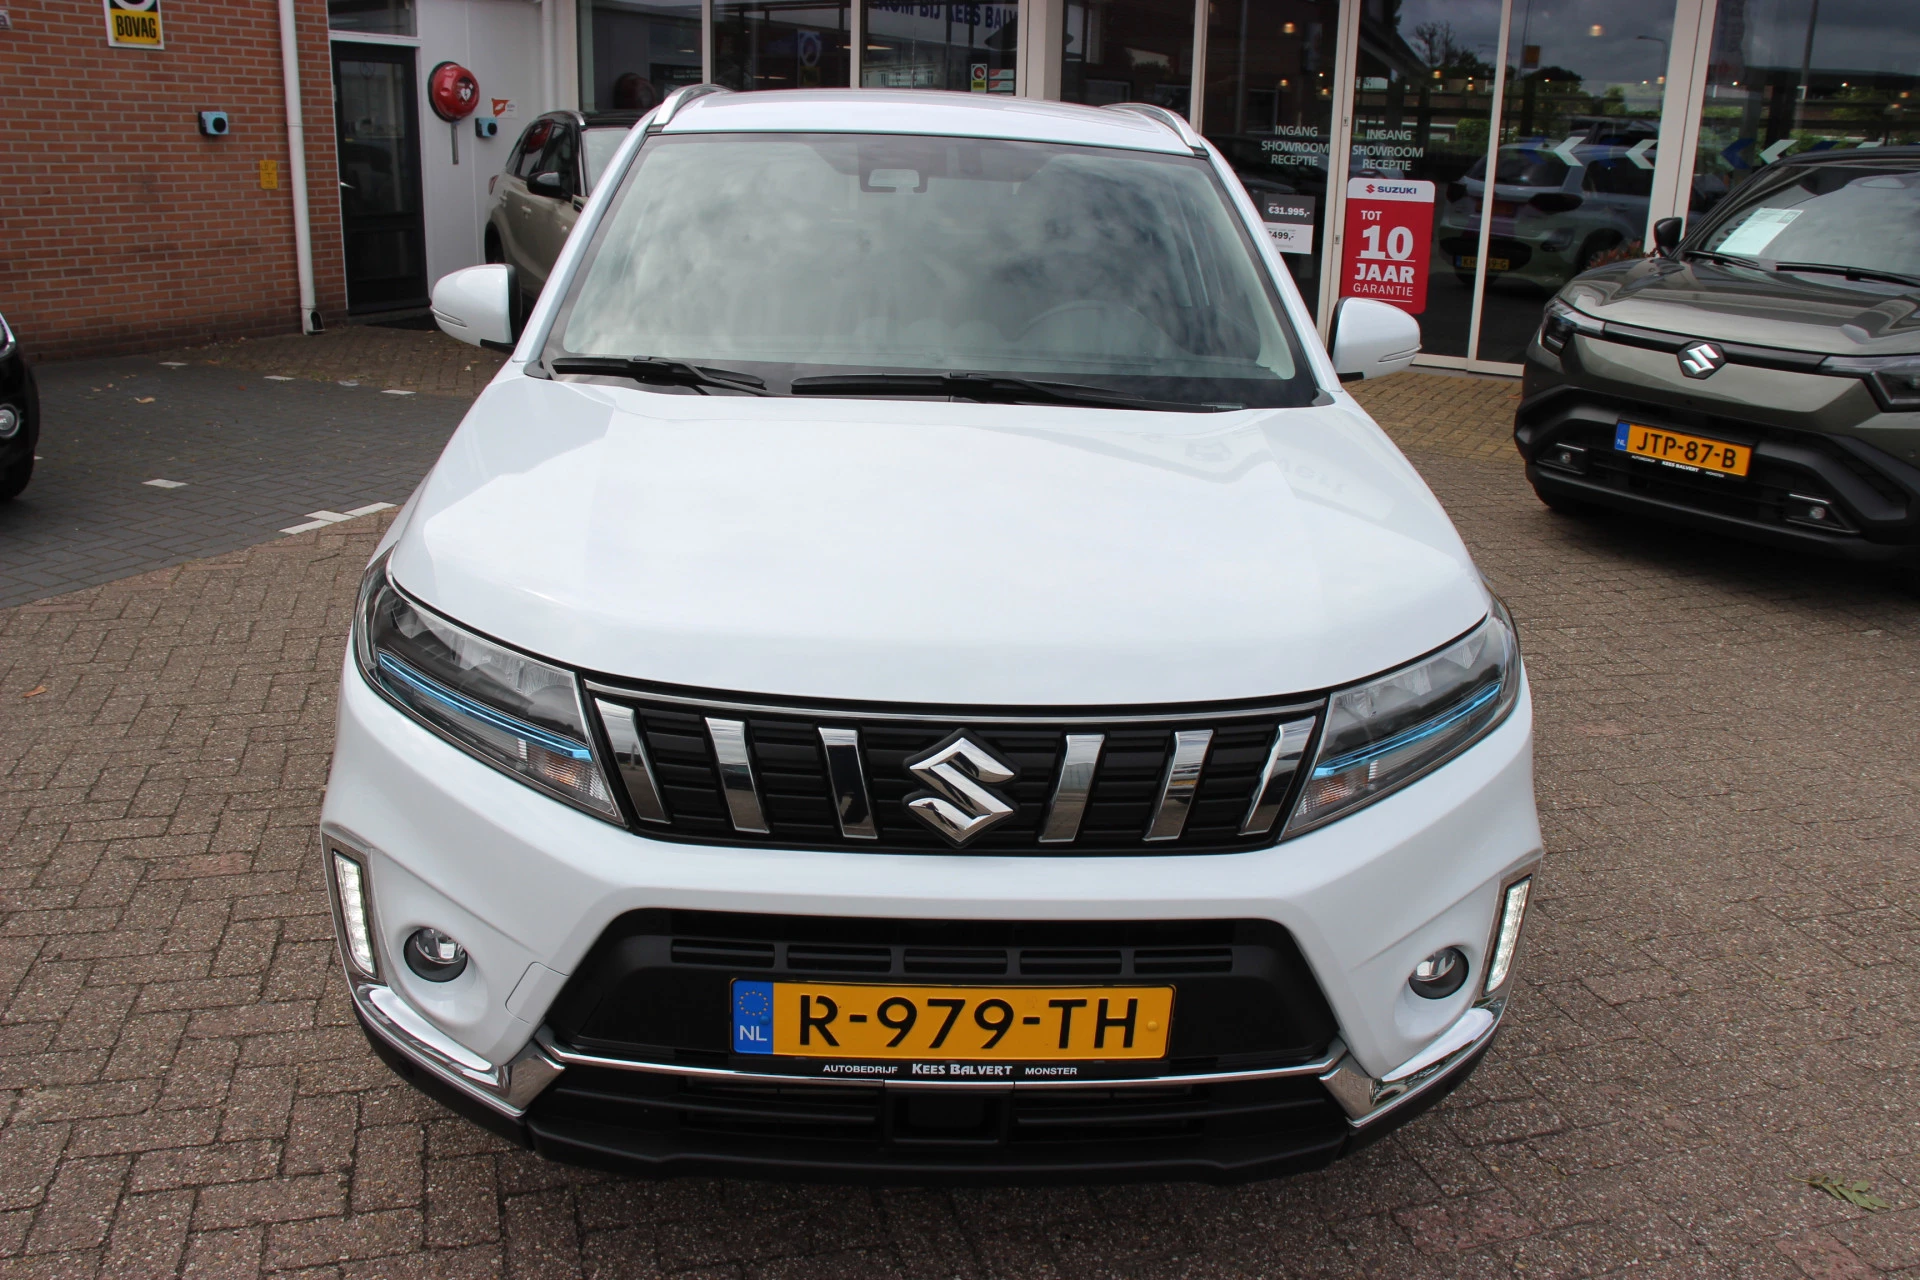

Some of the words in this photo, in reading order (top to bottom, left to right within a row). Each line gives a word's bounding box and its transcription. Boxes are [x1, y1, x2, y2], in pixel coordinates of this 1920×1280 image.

[115, 14, 157, 39] BOVAG
[1274, 125, 1318, 137] INGANG
[1366, 129, 1412, 141] INGANG
[1261, 140, 1330, 153] SHOWROOM
[1352, 145, 1424, 158] SHOWROOM
[1271, 154, 1318, 166] RECEPTIE
[1362, 158, 1412, 171] RECEPTIE
[1377, 185, 1417, 194] SUZUKI
[1360, 210, 1382, 220] TOT
[1360, 225, 1414, 261] 10
[1354, 263, 1415, 284] JAAR
[1353, 283, 1414, 297] GARANTIE
[1636, 432, 1737, 469] JTP-87-B
[739, 1024, 768, 1042] NL
[799, 993, 1138, 1050] R-979-TH
[823, 1064, 899, 1074] AUTOBEDRIJF
[912, 1063, 946, 1075] KEES
[950, 1064, 1013, 1076] BALVERT
[1025, 1067, 1078, 1075] MONSTER
